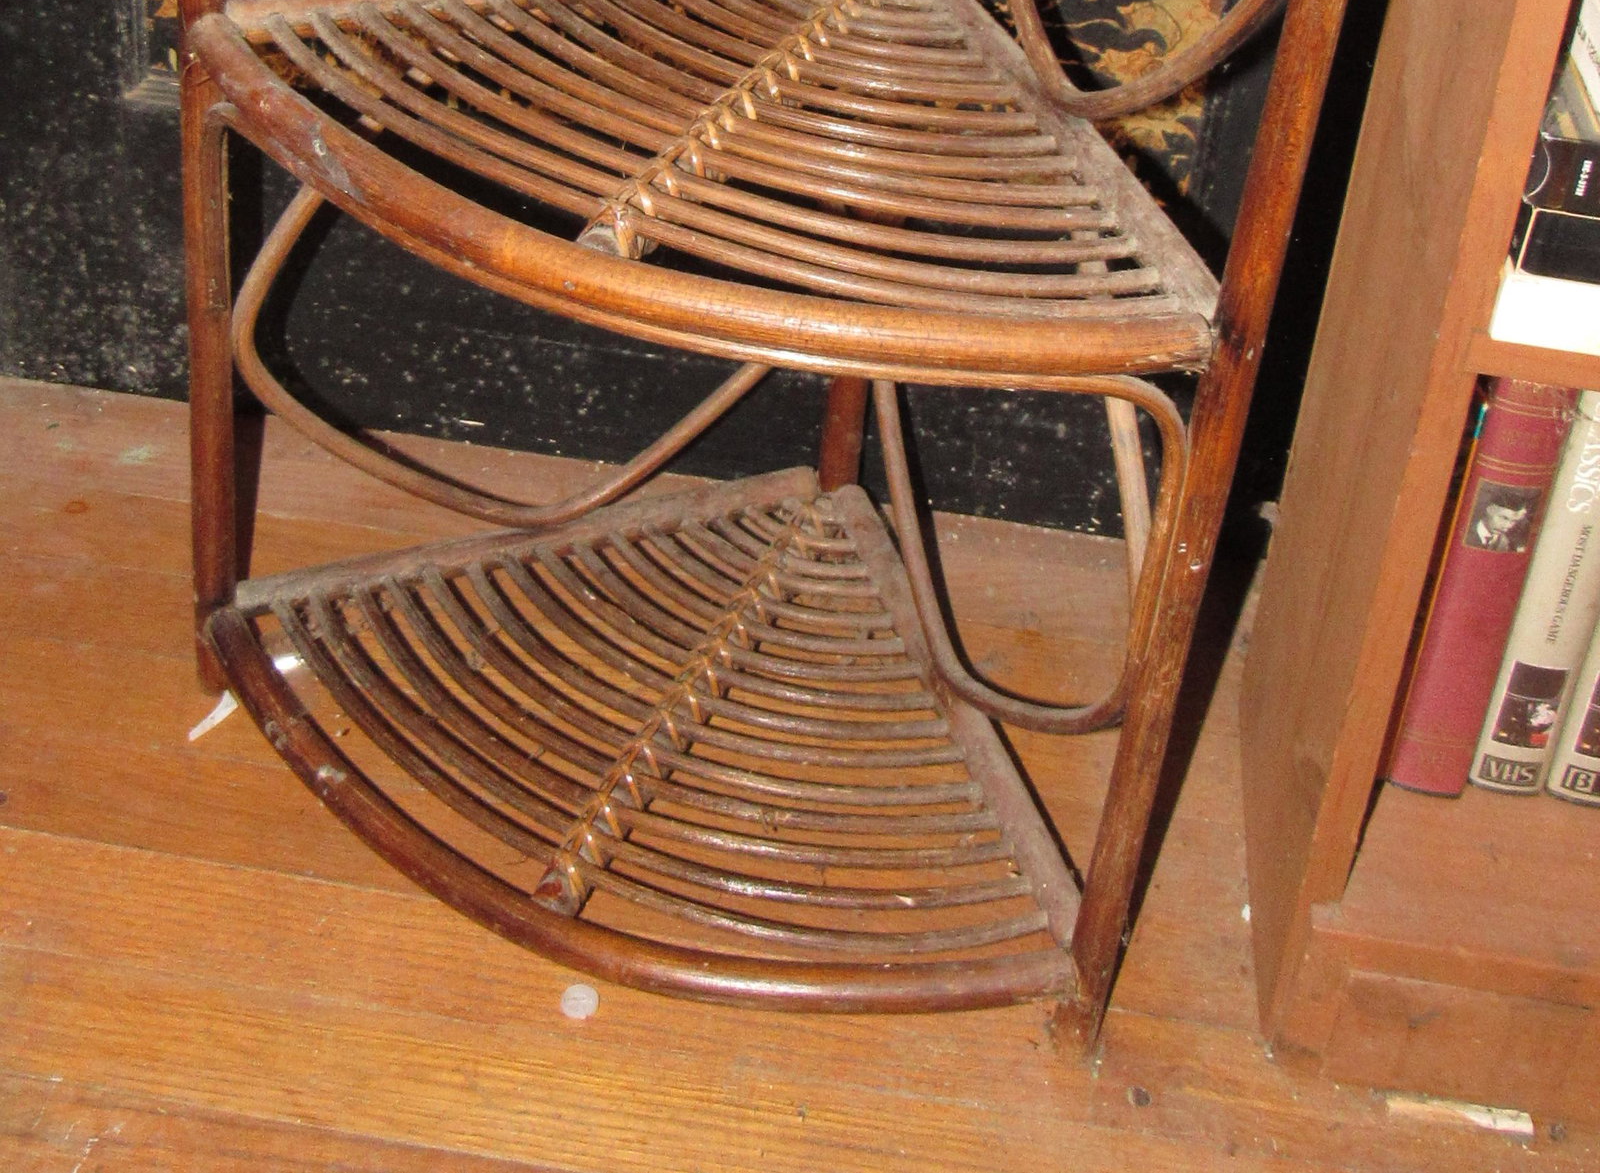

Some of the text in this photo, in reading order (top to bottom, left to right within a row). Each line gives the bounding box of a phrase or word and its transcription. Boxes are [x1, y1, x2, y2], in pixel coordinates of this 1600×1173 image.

[1567, 400, 1600, 514] ASSICS
[1545, 614, 1563, 644] GAME
[1487, 759, 1535, 783] VHS
